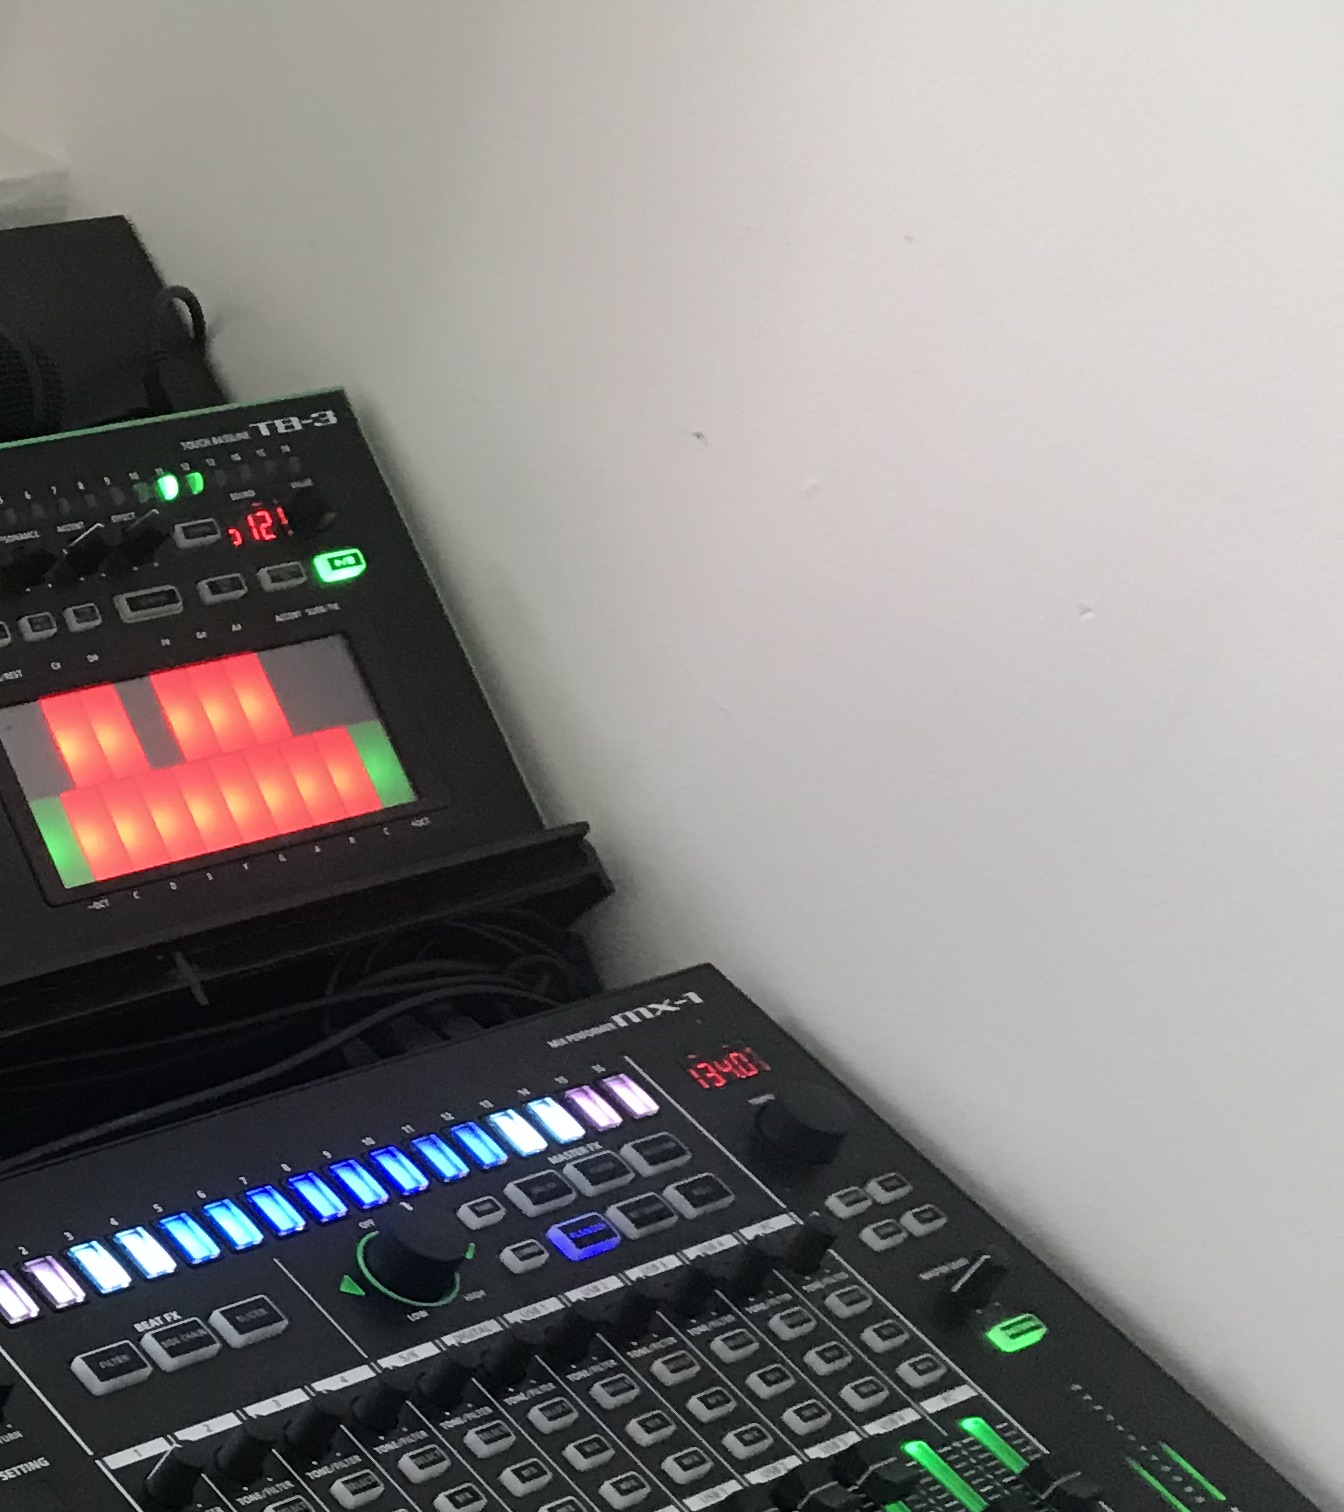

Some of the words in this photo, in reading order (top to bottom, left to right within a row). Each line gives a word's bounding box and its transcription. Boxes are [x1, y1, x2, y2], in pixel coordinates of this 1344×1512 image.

[249, 410, 338, 438] TB-3
[133, 1315, 162, 1333] BEAT
[162, 1308, 183, 1325] FX
[235, 1478, 296, 1506] TONE/FILTER
